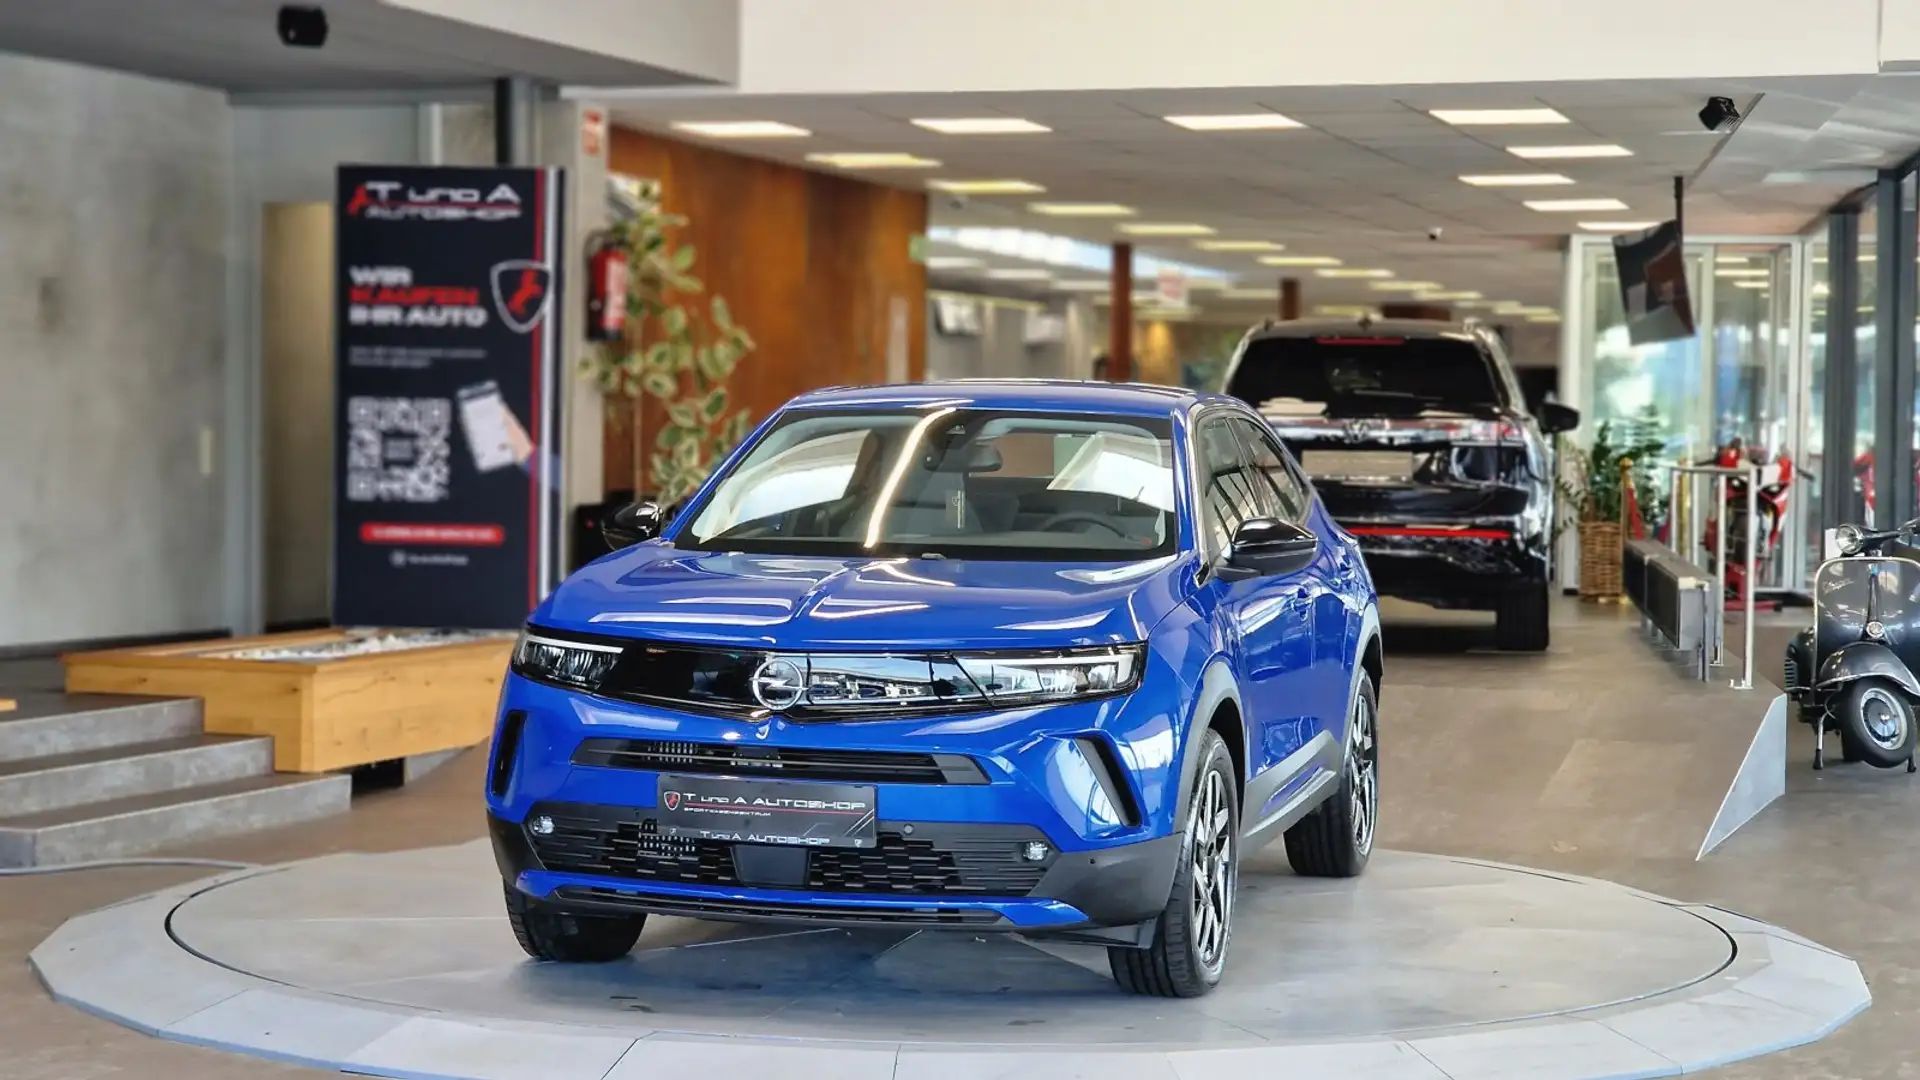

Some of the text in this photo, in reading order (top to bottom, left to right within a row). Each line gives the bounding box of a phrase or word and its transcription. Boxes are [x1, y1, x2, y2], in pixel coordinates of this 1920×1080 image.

[365, 181, 402, 201] T
[485, 183, 522, 204] A
[349, 266, 412, 285] WIR
[349, 287, 479, 306] KAUFEN
[349, 305, 488, 327] IHR AUTO
[683, 793, 696, 801] T
[734, 796, 747, 804] A
[753, 798, 865, 810] AUTOSHOP
[700, 830, 710, 839] T
[748, 834, 830, 845] AUTOSHOP
